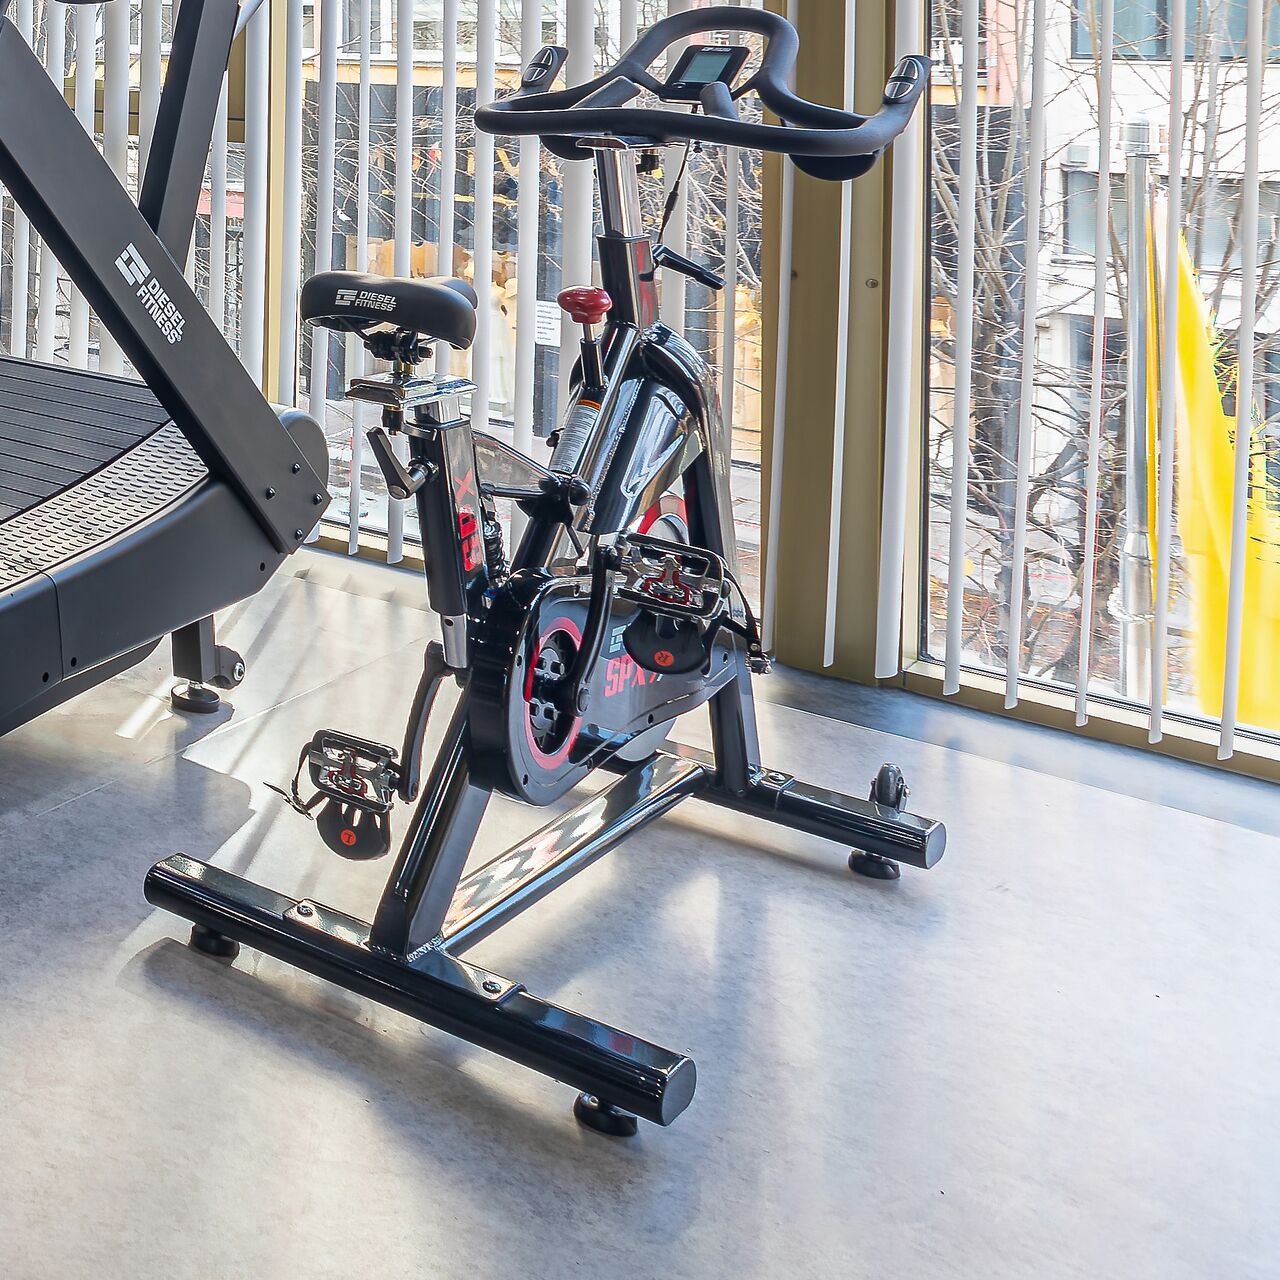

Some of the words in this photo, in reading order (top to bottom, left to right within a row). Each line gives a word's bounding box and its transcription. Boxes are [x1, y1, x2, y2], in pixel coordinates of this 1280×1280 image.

[136, 284, 180, 344] FITNESS
[147, 277, 186, 334] DIESEL
[354, 298, 395, 312] FITNESS
[359, 290, 397, 305] DIESEL
